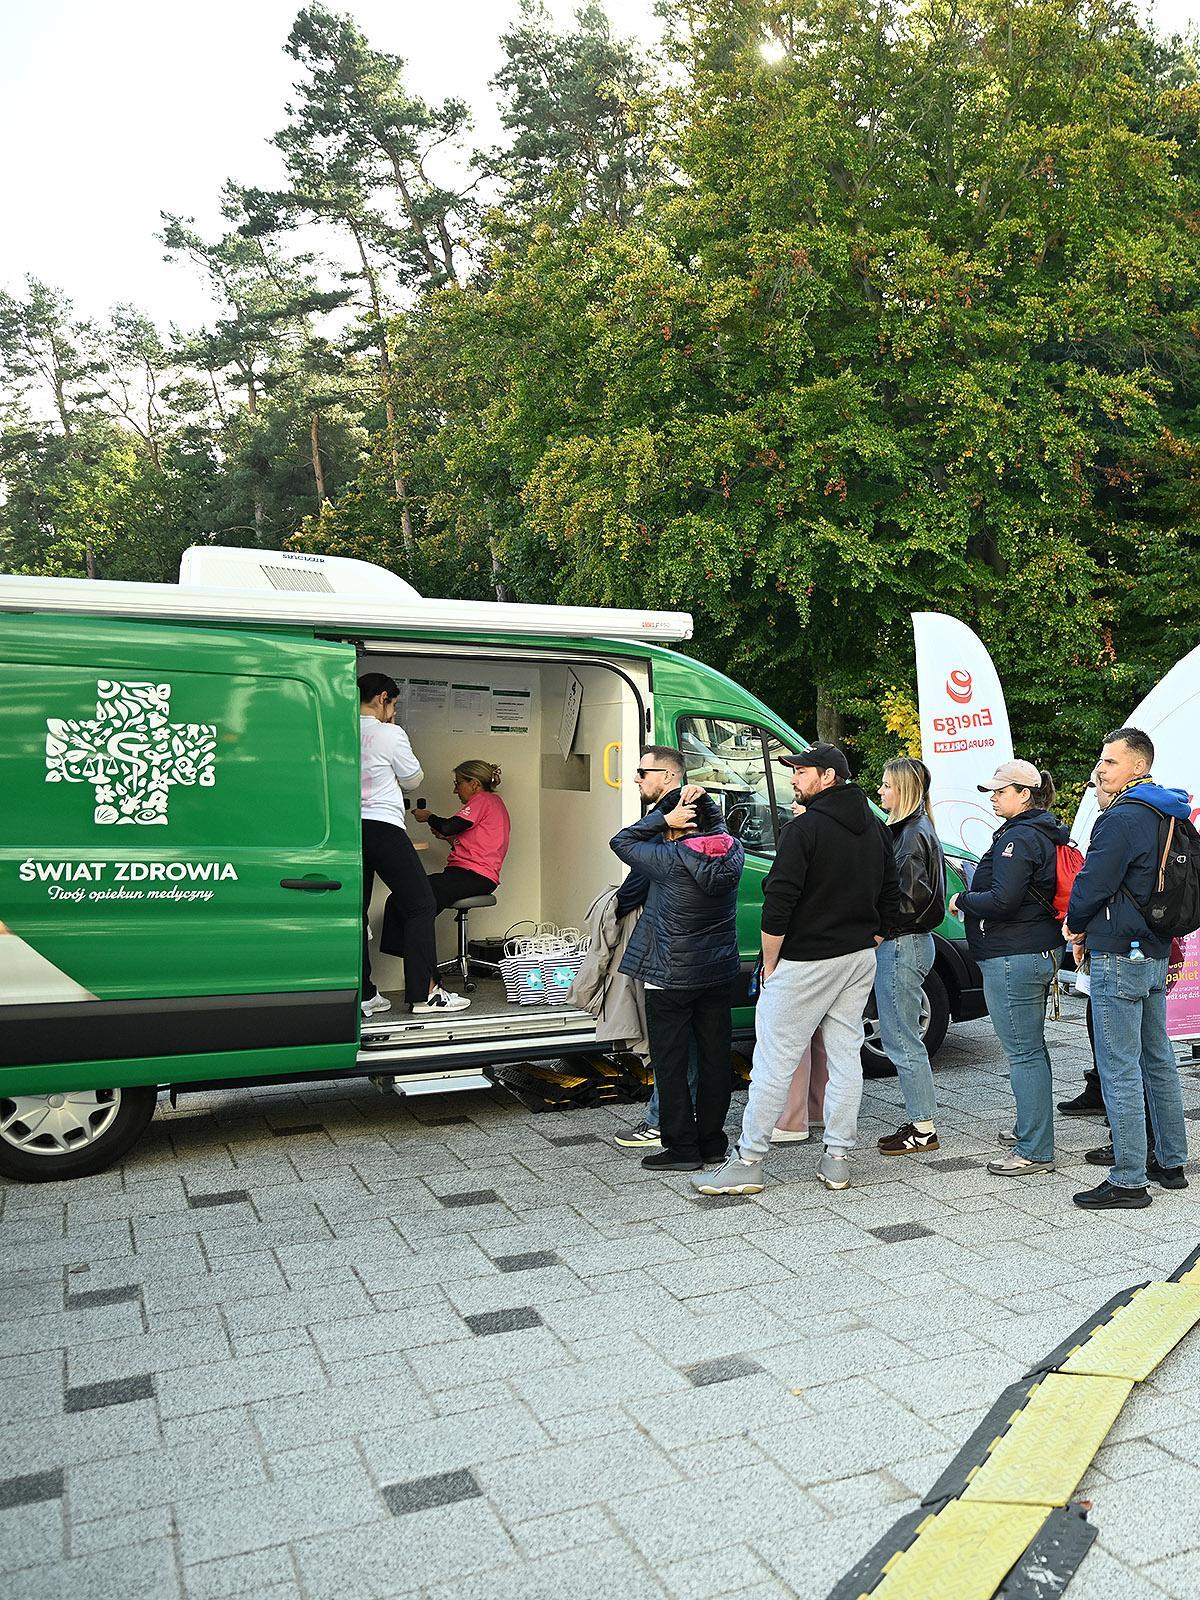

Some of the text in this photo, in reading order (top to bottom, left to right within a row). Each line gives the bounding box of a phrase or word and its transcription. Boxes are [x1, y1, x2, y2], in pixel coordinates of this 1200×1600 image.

[19, 858, 239, 881] ŚWIAT ZDROWIA
[47, 885, 215, 902] Twój opiekun medyczny
[1165, 970, 1199, 985] pakiet
